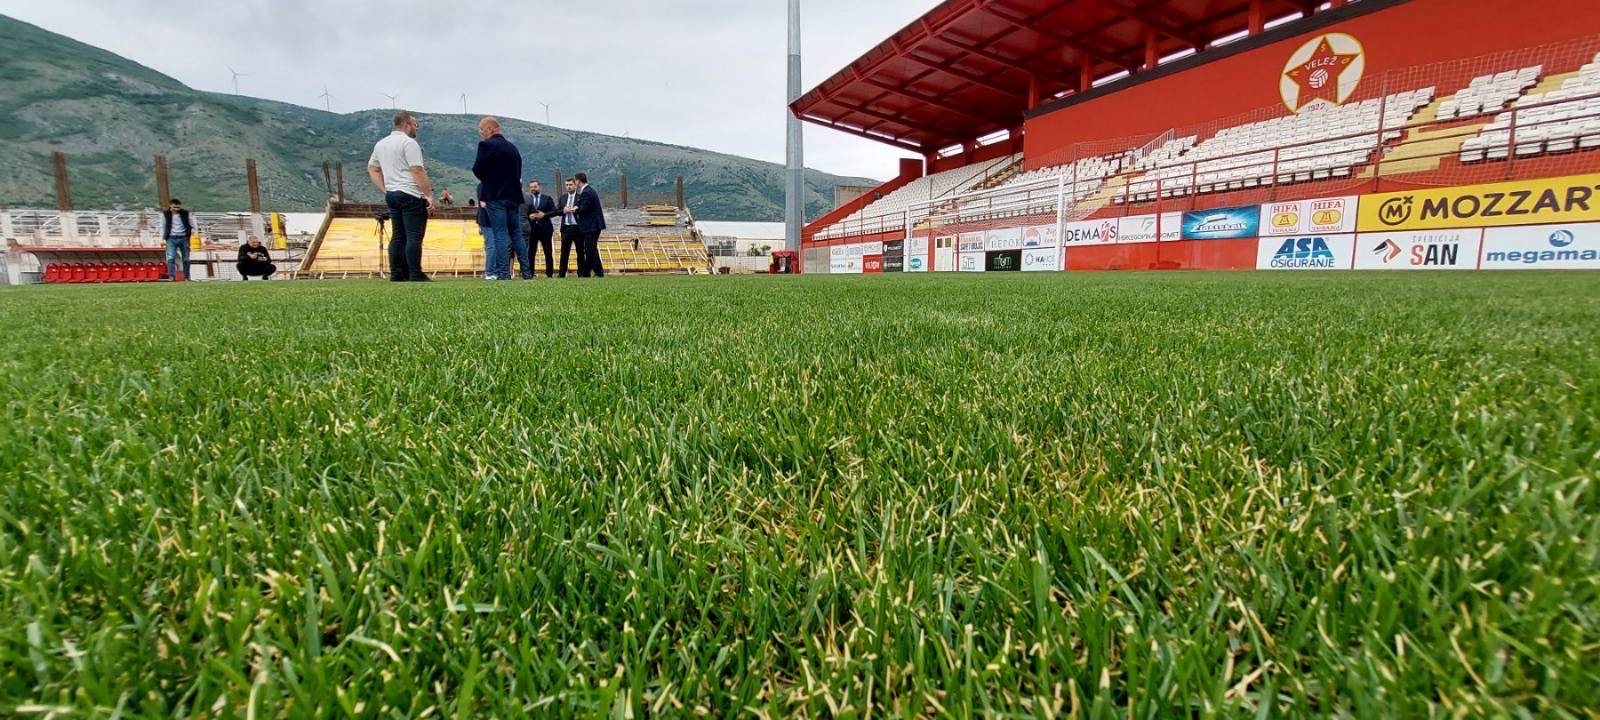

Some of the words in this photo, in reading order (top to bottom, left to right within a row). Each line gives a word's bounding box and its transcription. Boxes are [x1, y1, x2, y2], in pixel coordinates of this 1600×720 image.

[1304, 55, 1338, 71] VELEŽ
[1273, 204, 1298, 213] HIFA
[1313, 201, 1342, 210] HIFA
[1273, 237, 1334, 259] ASA
[1410, 244, 1459, 266] SAN
[1270, 258, 1335, 268] OSIGURANJE
[1486, 249, 1600, 264] megama
